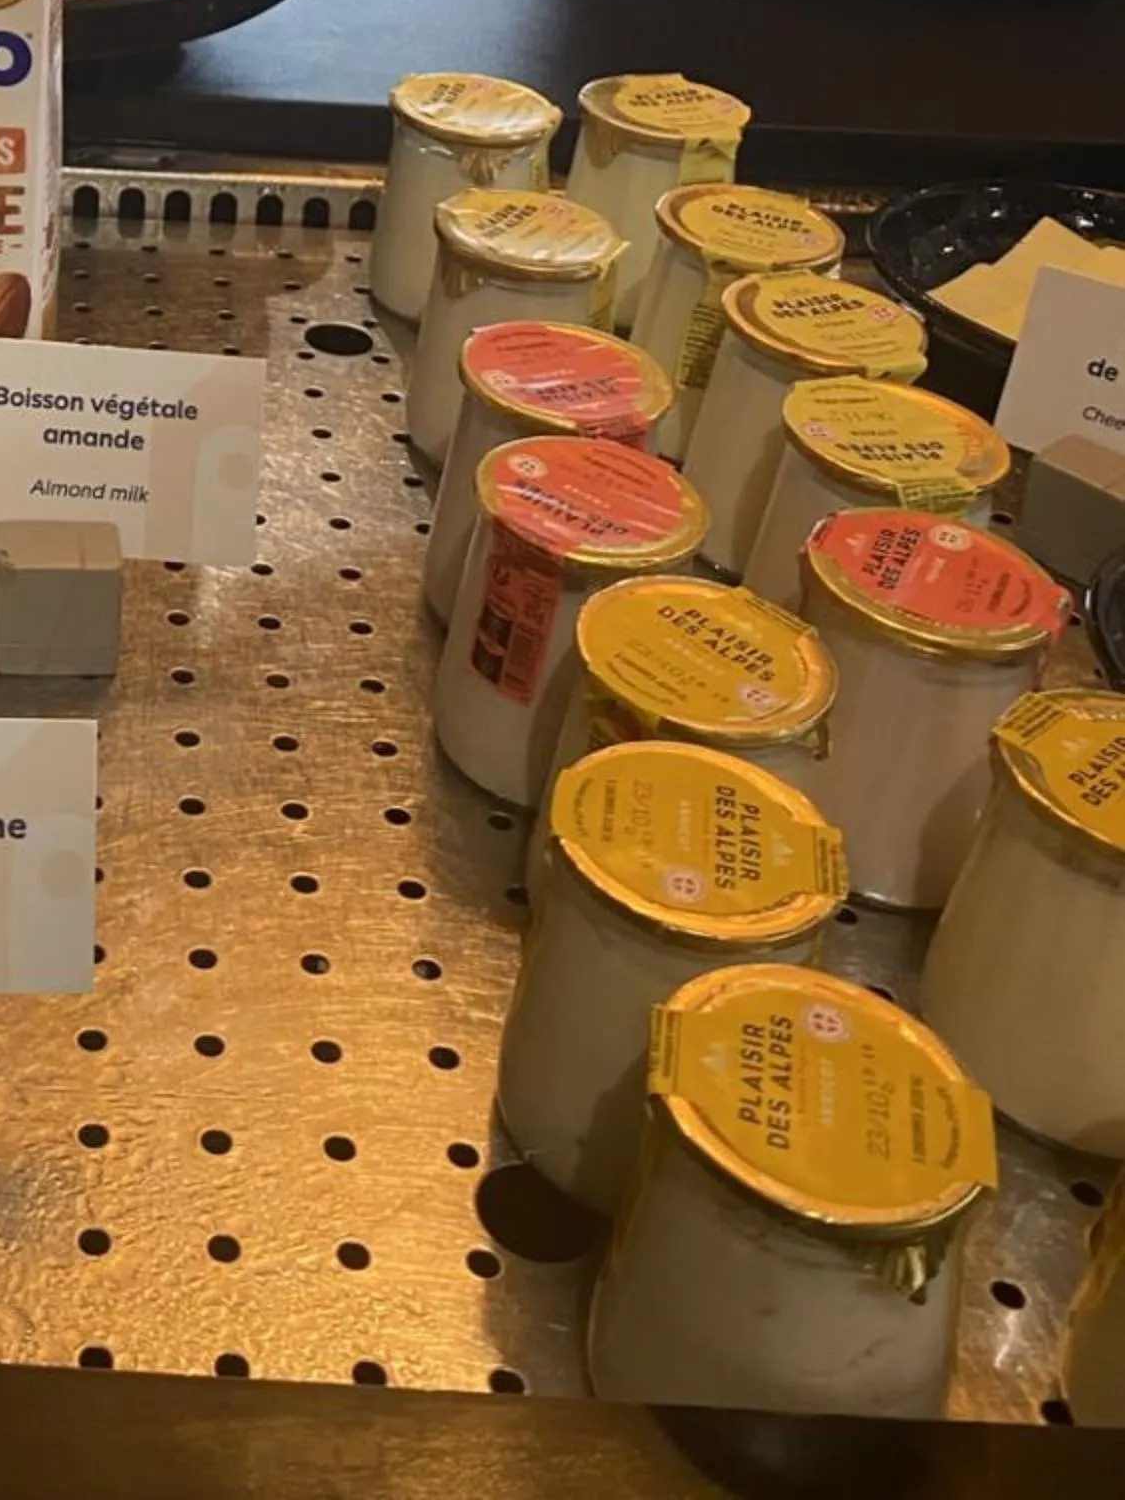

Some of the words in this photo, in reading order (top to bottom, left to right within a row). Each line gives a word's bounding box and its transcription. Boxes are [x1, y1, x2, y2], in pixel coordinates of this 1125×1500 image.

[1087, 358, 1119, 382] de
[91, 395, 199, 421] végétale
[42, 425, 146, 450] amande
[30, 478, 106, 500] Almond
[110, 485, 150, 504] milk
[862, 528, 898, 577] PLAISIR
[657, 604, 703, 638] DES
[703, 638, 777, 684] ALPES
[683, 607, 774, 667] PLAISIR
[715, 784, 737, 820] DES
[1081, 778, 1121, 806] DES
[714, 825, 737, 892] ALPES
[738, 803, 762, 882] PLAISIR
[738, 1022, 767, 1125] PLAISIR
[769, 1016, 795, 1092] ALPES
[767, 1095, 792, 1151] DES
